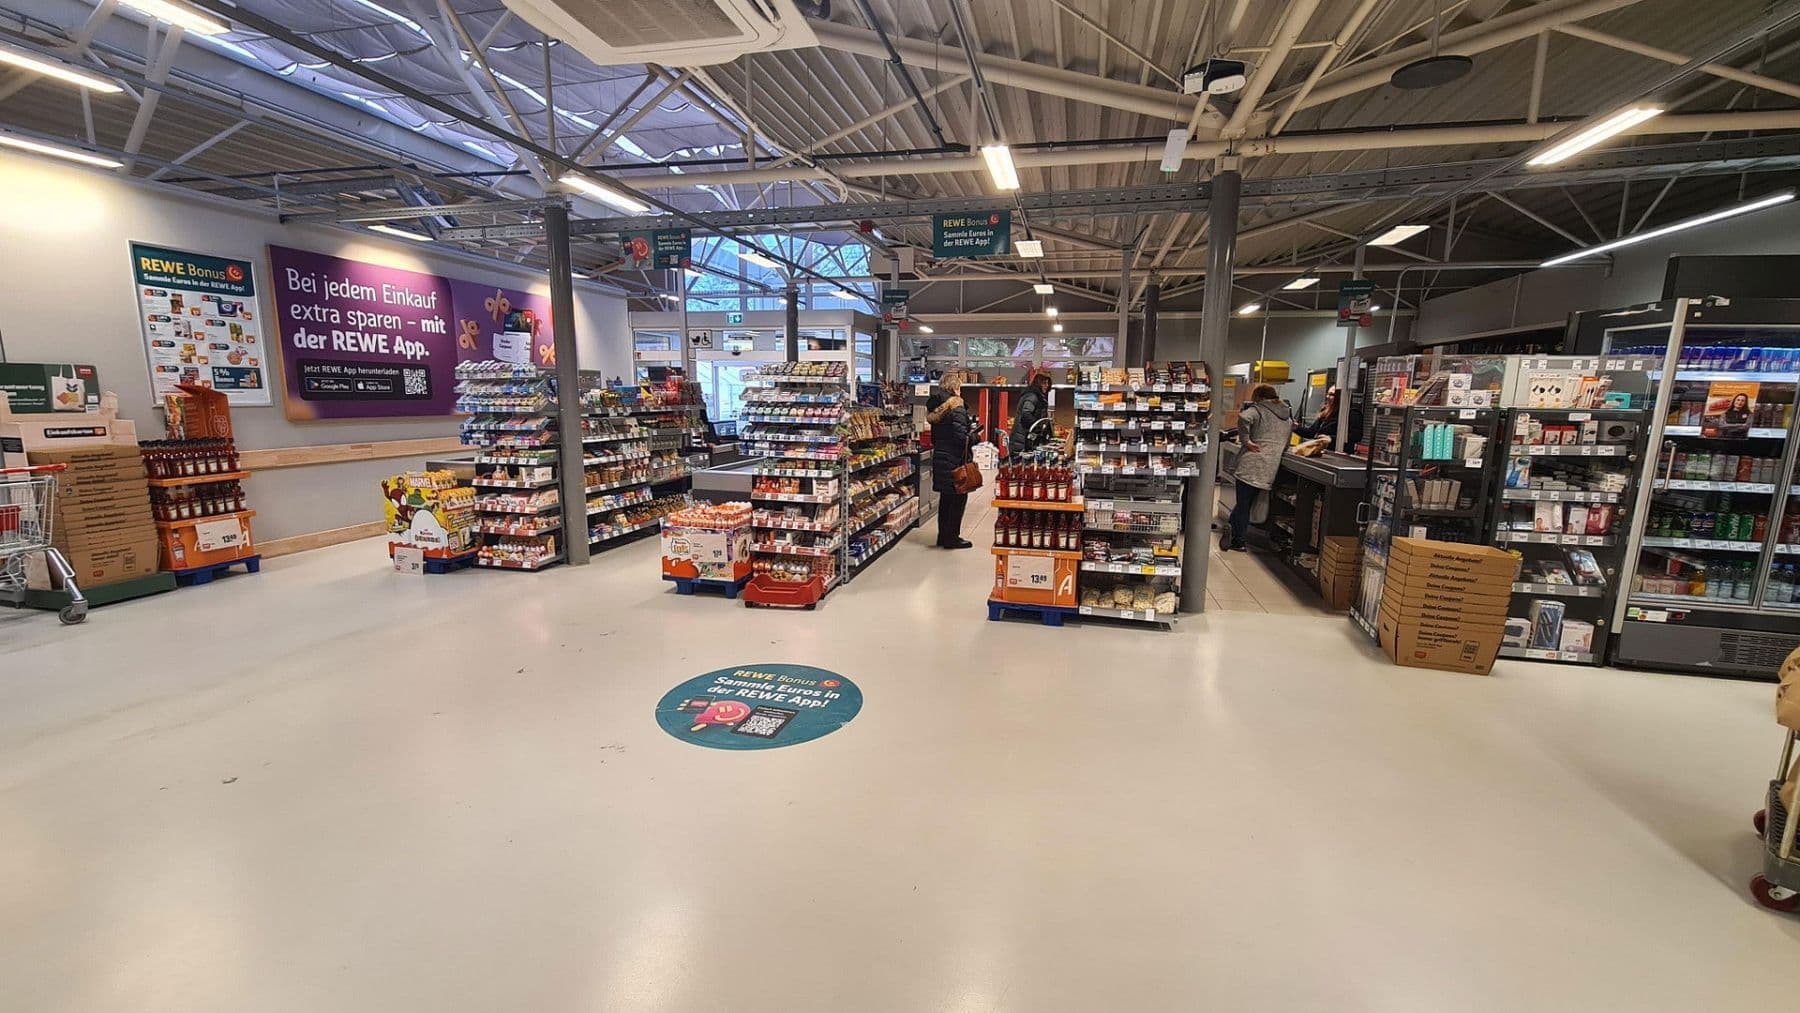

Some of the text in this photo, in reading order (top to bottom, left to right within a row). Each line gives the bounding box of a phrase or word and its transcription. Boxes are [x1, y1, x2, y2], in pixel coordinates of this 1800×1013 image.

[943, 219, 966, 228] REWE
[975, 238, 990, 246] App!
[140, 256, 225, 280] REWE Bonus
[144, 273, 171, 283] Sammle
[172, 277, 191, 285] Euros
[210, 281, 230, 290] REWE
[231, 283, 245, 292] App!
[286, 267, 437, 310] Bei jedem Einkauf
[290, 303, 341, 324] extra
[347, 309, 402, 330] sparen
[421, 315, 447, 334] mit
[293, 326, 430, 360] der REWE App.
[304, 365, 320, 373] Jetzt
[344, 367, 357, 375] App
[358, 367, 399, 375] herunterladen
[320, 383, 338, 391] Google
[410, 477, 432, 488] MARVEL
[733, 669, 817, 686] REWE Bonus
[706, 685, 831, 708] der REWE App!
[713, 676, 841, 700] Sammle Euros in
